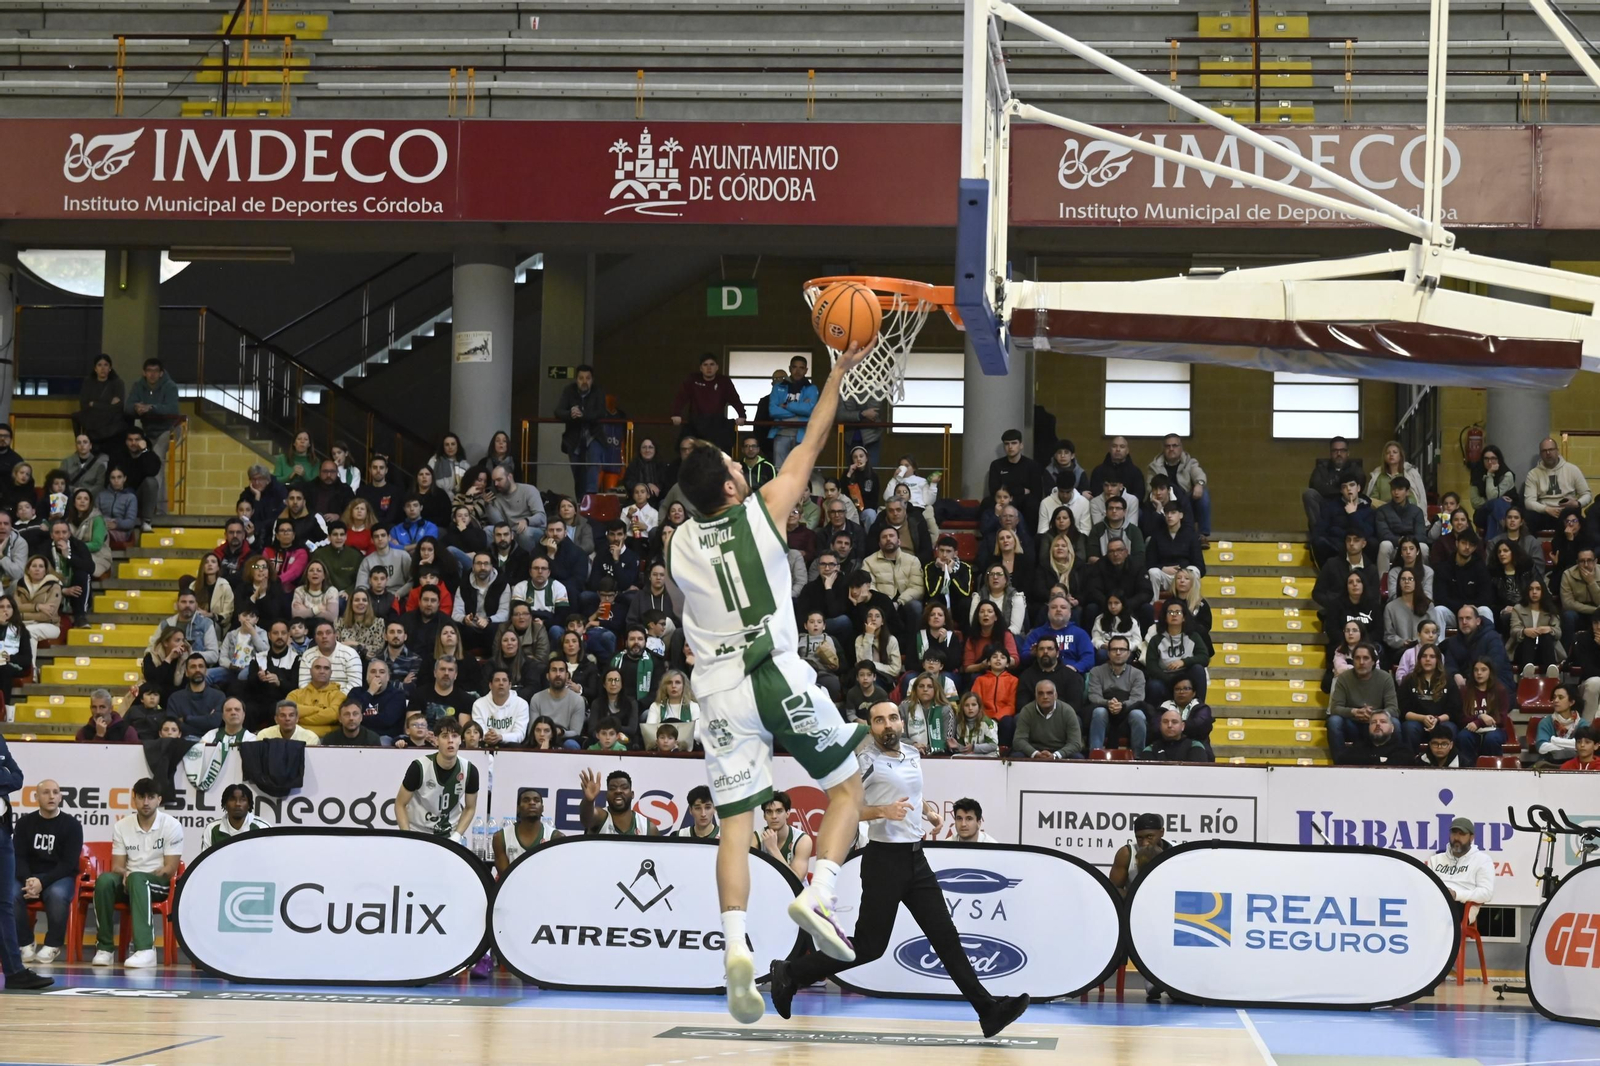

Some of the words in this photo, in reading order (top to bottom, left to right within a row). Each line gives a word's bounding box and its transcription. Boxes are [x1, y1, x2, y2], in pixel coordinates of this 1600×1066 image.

[153, 128, 448, 184] IMDECO
[689, 145, 839, 170] AYUNTAMIENTO
[1152, 133, 1461, 189] IMDECO
[689, 176, 714, 200] DE
[719, 173, 816, 201] CÓRDOBA
[63, 195, 139, 213] Instituto
[145, 196, 236, 216] Municipal
[242, 197, 266, 213] de
[271, 197, 358, 216] Deportes
[363, 195, 444, 214] Córdoba
[1059, 202, 1139, 220] Instituto
[1144, 202, 1241, 223] Municipal
[1247, 203, 1271, 221] de
[721, 286, 742, 310] D
[714, 769, 751, 789] efficold
[1200, 808, 1238, 834] RÍO
[1055, 836, 1113, 848] COCINA
[280, 883, 447, 935] Cualix
[945, 898, 1007, 921] YSA
[1246, 893, 1408, 928] REALE
[1245, 929, 1409, 954] SEGUROS
